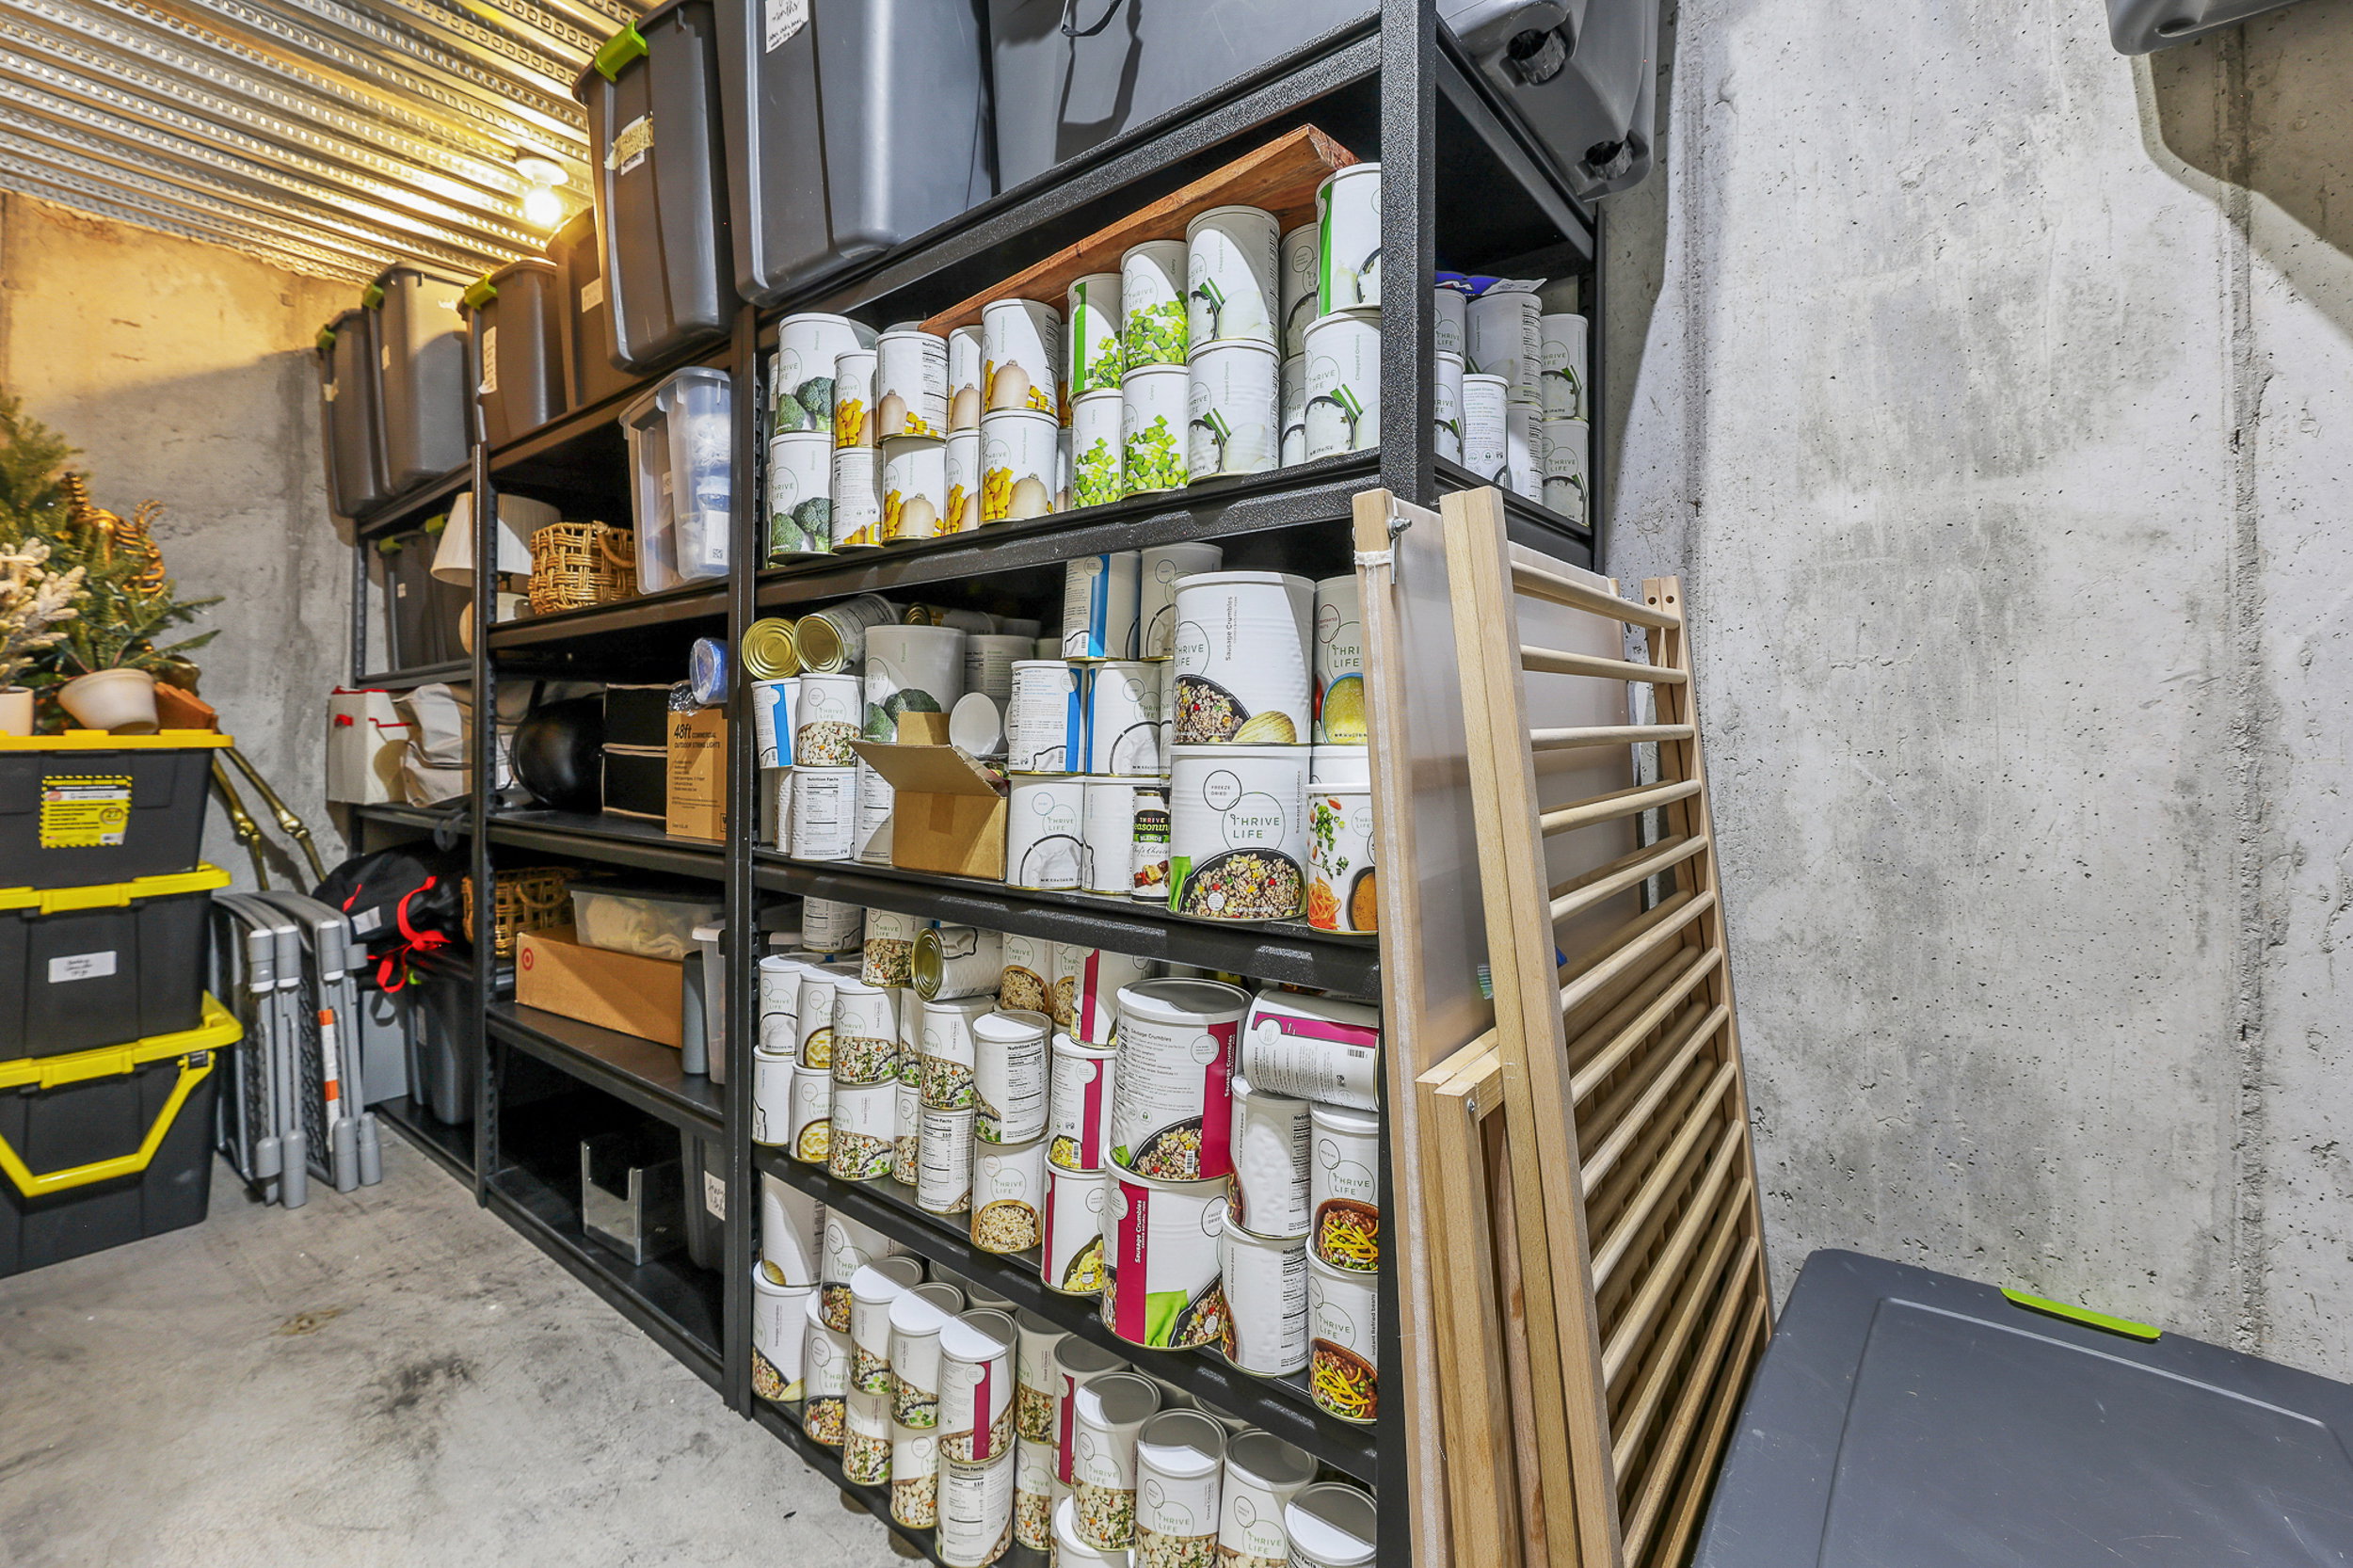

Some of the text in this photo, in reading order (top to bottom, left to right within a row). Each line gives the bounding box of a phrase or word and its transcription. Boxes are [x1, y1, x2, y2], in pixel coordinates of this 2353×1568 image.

[1437, 330, 1460, 341] THRIVE
[1308, 370, 1336, 385] THRIVE
[1310, 381, 1324, 393] LIFE
[1333, 645, 1359, 656] THRI
[1334, 659, 1360, 668] LIFE
[674, 723, 692, 739] 48ft
[1048, 816, 1074, 824] THRIVE
[1230, 814, 1280, 826] THRIVE
[1233, 829, 1263, 839] LIFE
[875, 923, 899, 932] THRIVE
[1131, 1028, 1172, 1042] Sausage Crumbles
[1007, 1043, 1031, 1051] Nutrition
[994, 1178, 1024, 1187] THRIVE
[1333, 1173, 1370, 1187] THRIVE
[1335, 1186, 1355, 1195] LIFE
[1318, 1313, 1351, 1334] THRIVE
[1320, 1325, 1337, 1339] LIFE
[950, 1464, 969, 1472] Nutrition
[1088, 1463, 1117, 1479] THRIVE
[1089, 1475, 1105, 1484] LIFE
[1157, 1512, 1190, 1527] THRIVE
[1159, 1525, 1176, 1533] LIFE
[1247, 1530, 1282, 1546] THRIVE
[1248, 1544, 1269, 1554] LIFE
